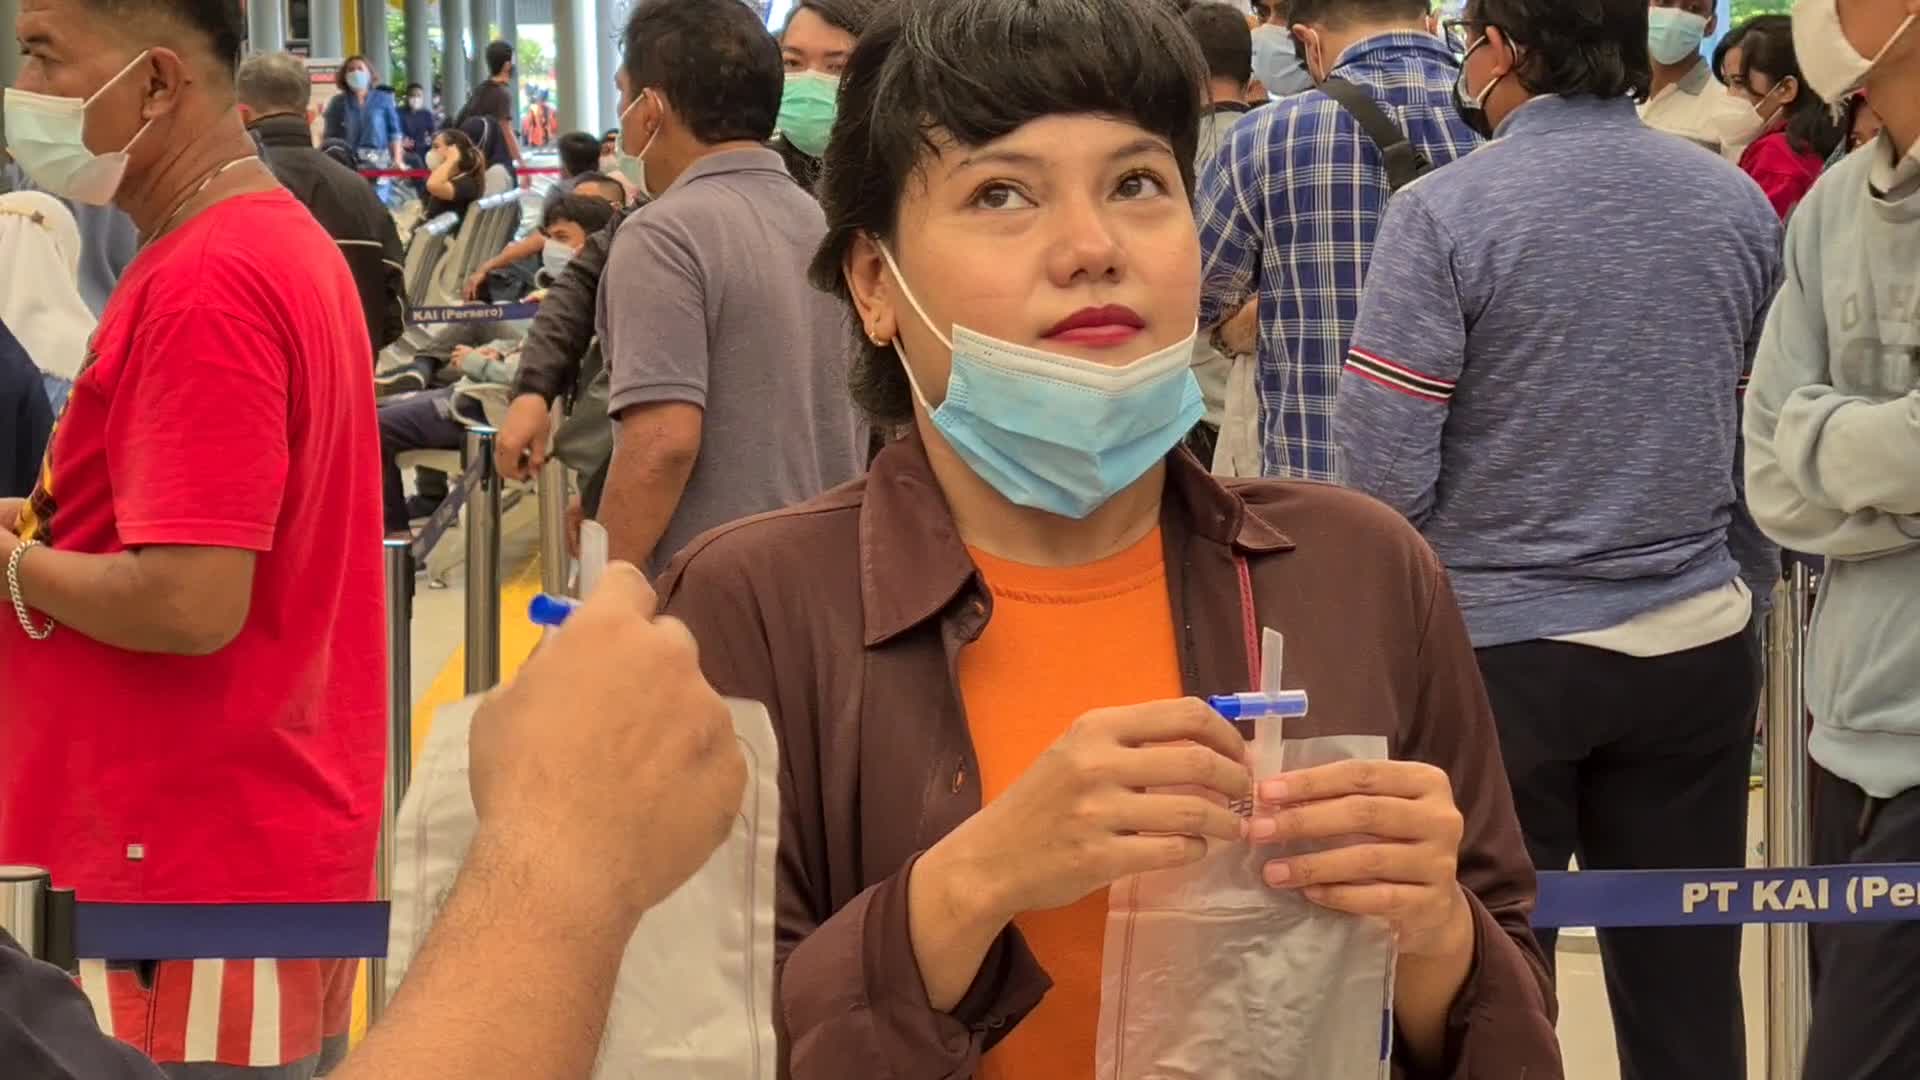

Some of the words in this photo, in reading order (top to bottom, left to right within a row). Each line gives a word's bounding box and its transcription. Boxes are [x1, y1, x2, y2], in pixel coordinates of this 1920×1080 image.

[413, 309, 437, 320] KAI
[1682, 882, 1738, 913] PT
[1752, 878, 1829, 911] KAI
[1846, 876, 1920, 914] (Pe
